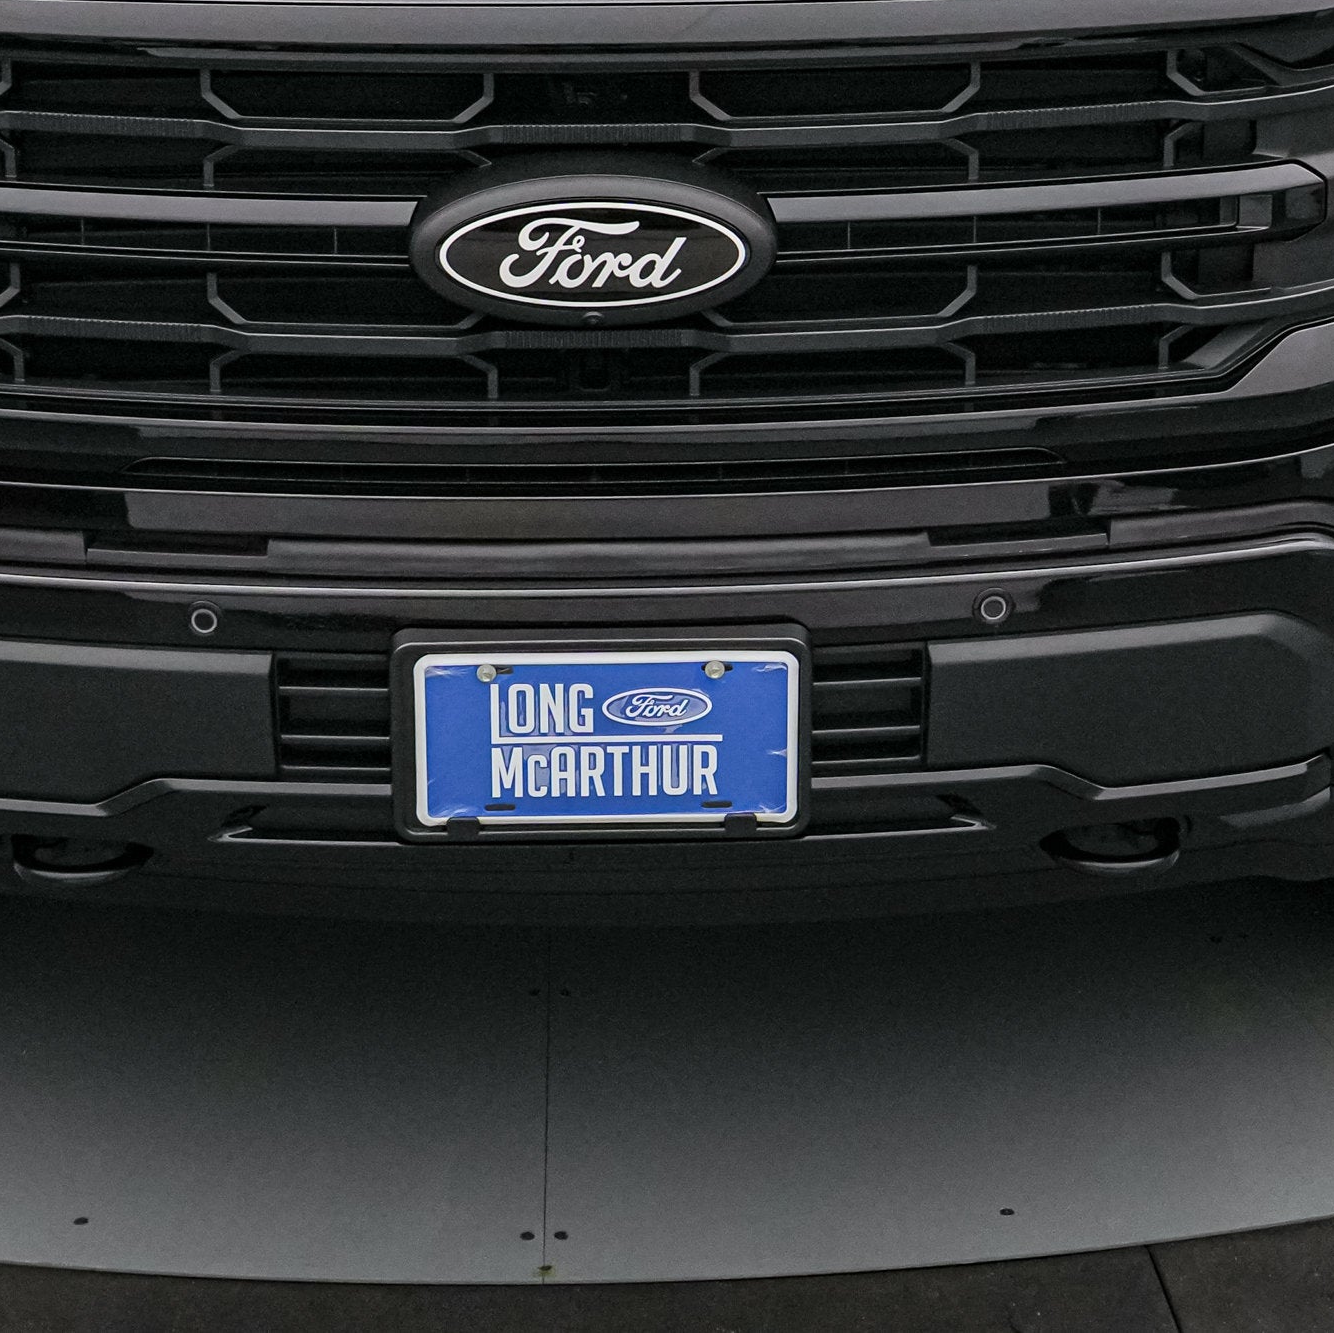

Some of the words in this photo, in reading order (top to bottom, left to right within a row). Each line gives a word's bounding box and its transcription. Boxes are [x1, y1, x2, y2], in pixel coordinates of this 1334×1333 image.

[499, 217, 687, 289] Ford
[490, 683, 594, 744] LONG
[624, 693, 688, 718] Ford
[490, 744, 719, 799] McARTHUR
